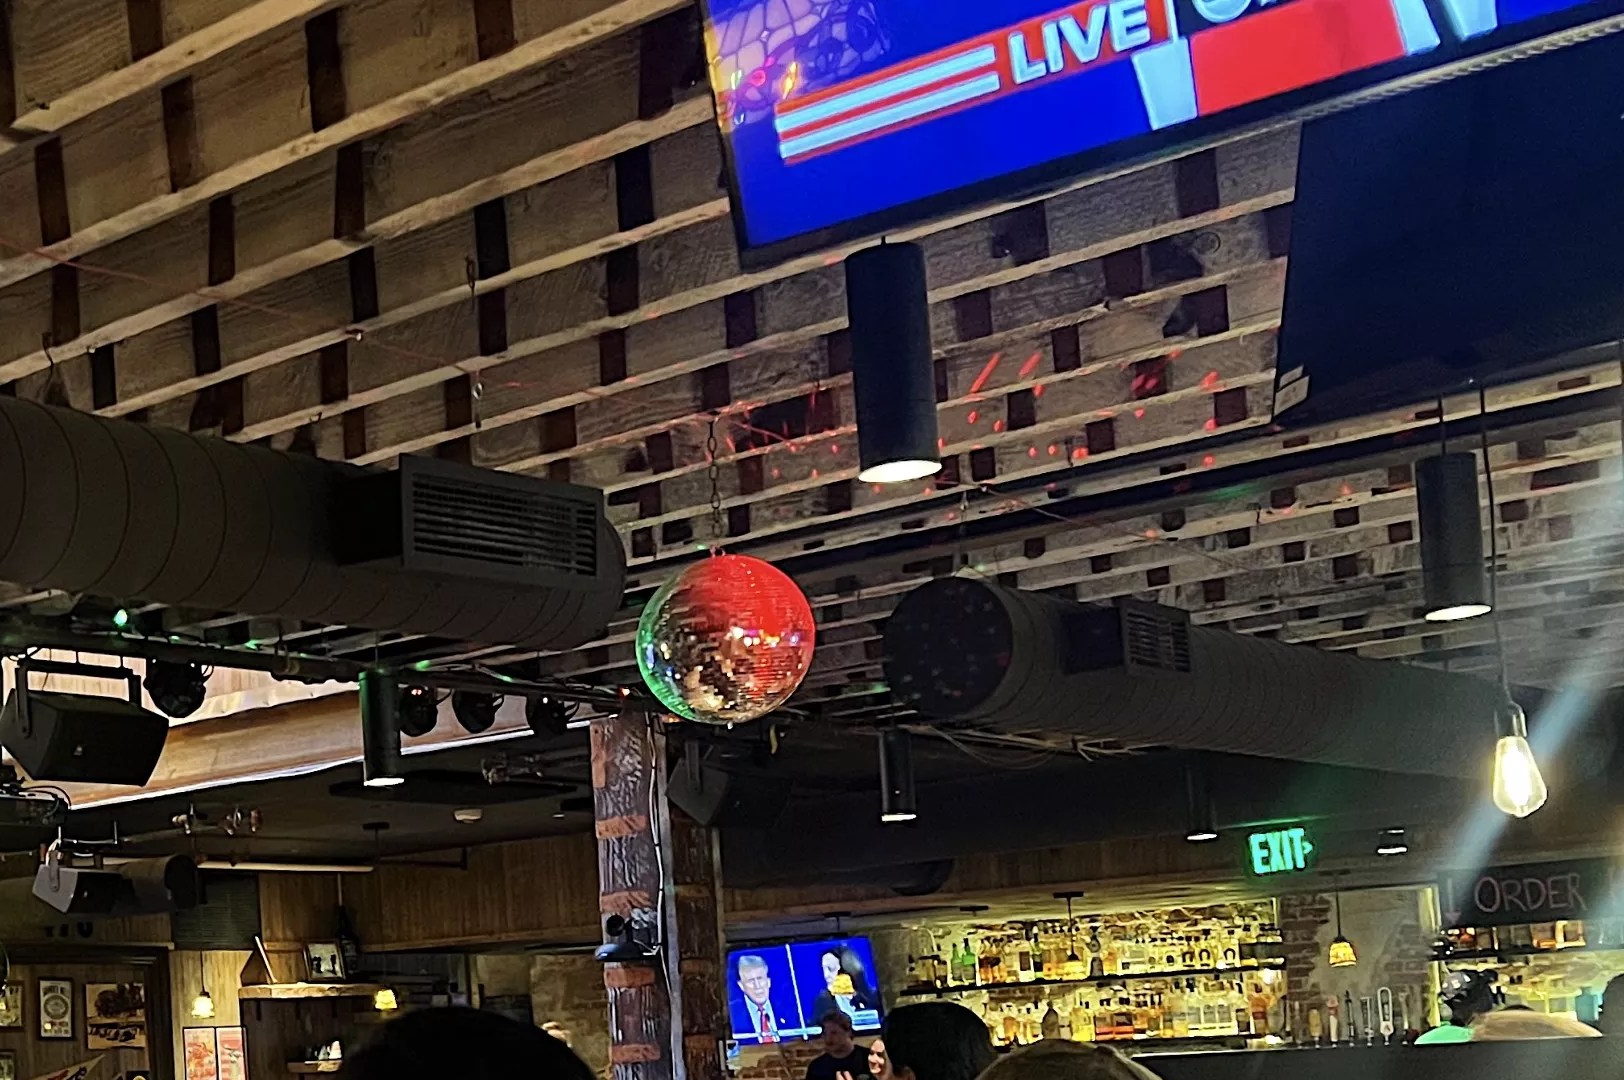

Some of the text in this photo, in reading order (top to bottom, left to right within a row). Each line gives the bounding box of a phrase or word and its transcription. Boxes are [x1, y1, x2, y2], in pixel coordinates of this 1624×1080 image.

[1008, 0, 1151, 84] LIVE
[1249, 828, 1305, 875] EXIT
[1475, 873, 1588, 913] ORDER
